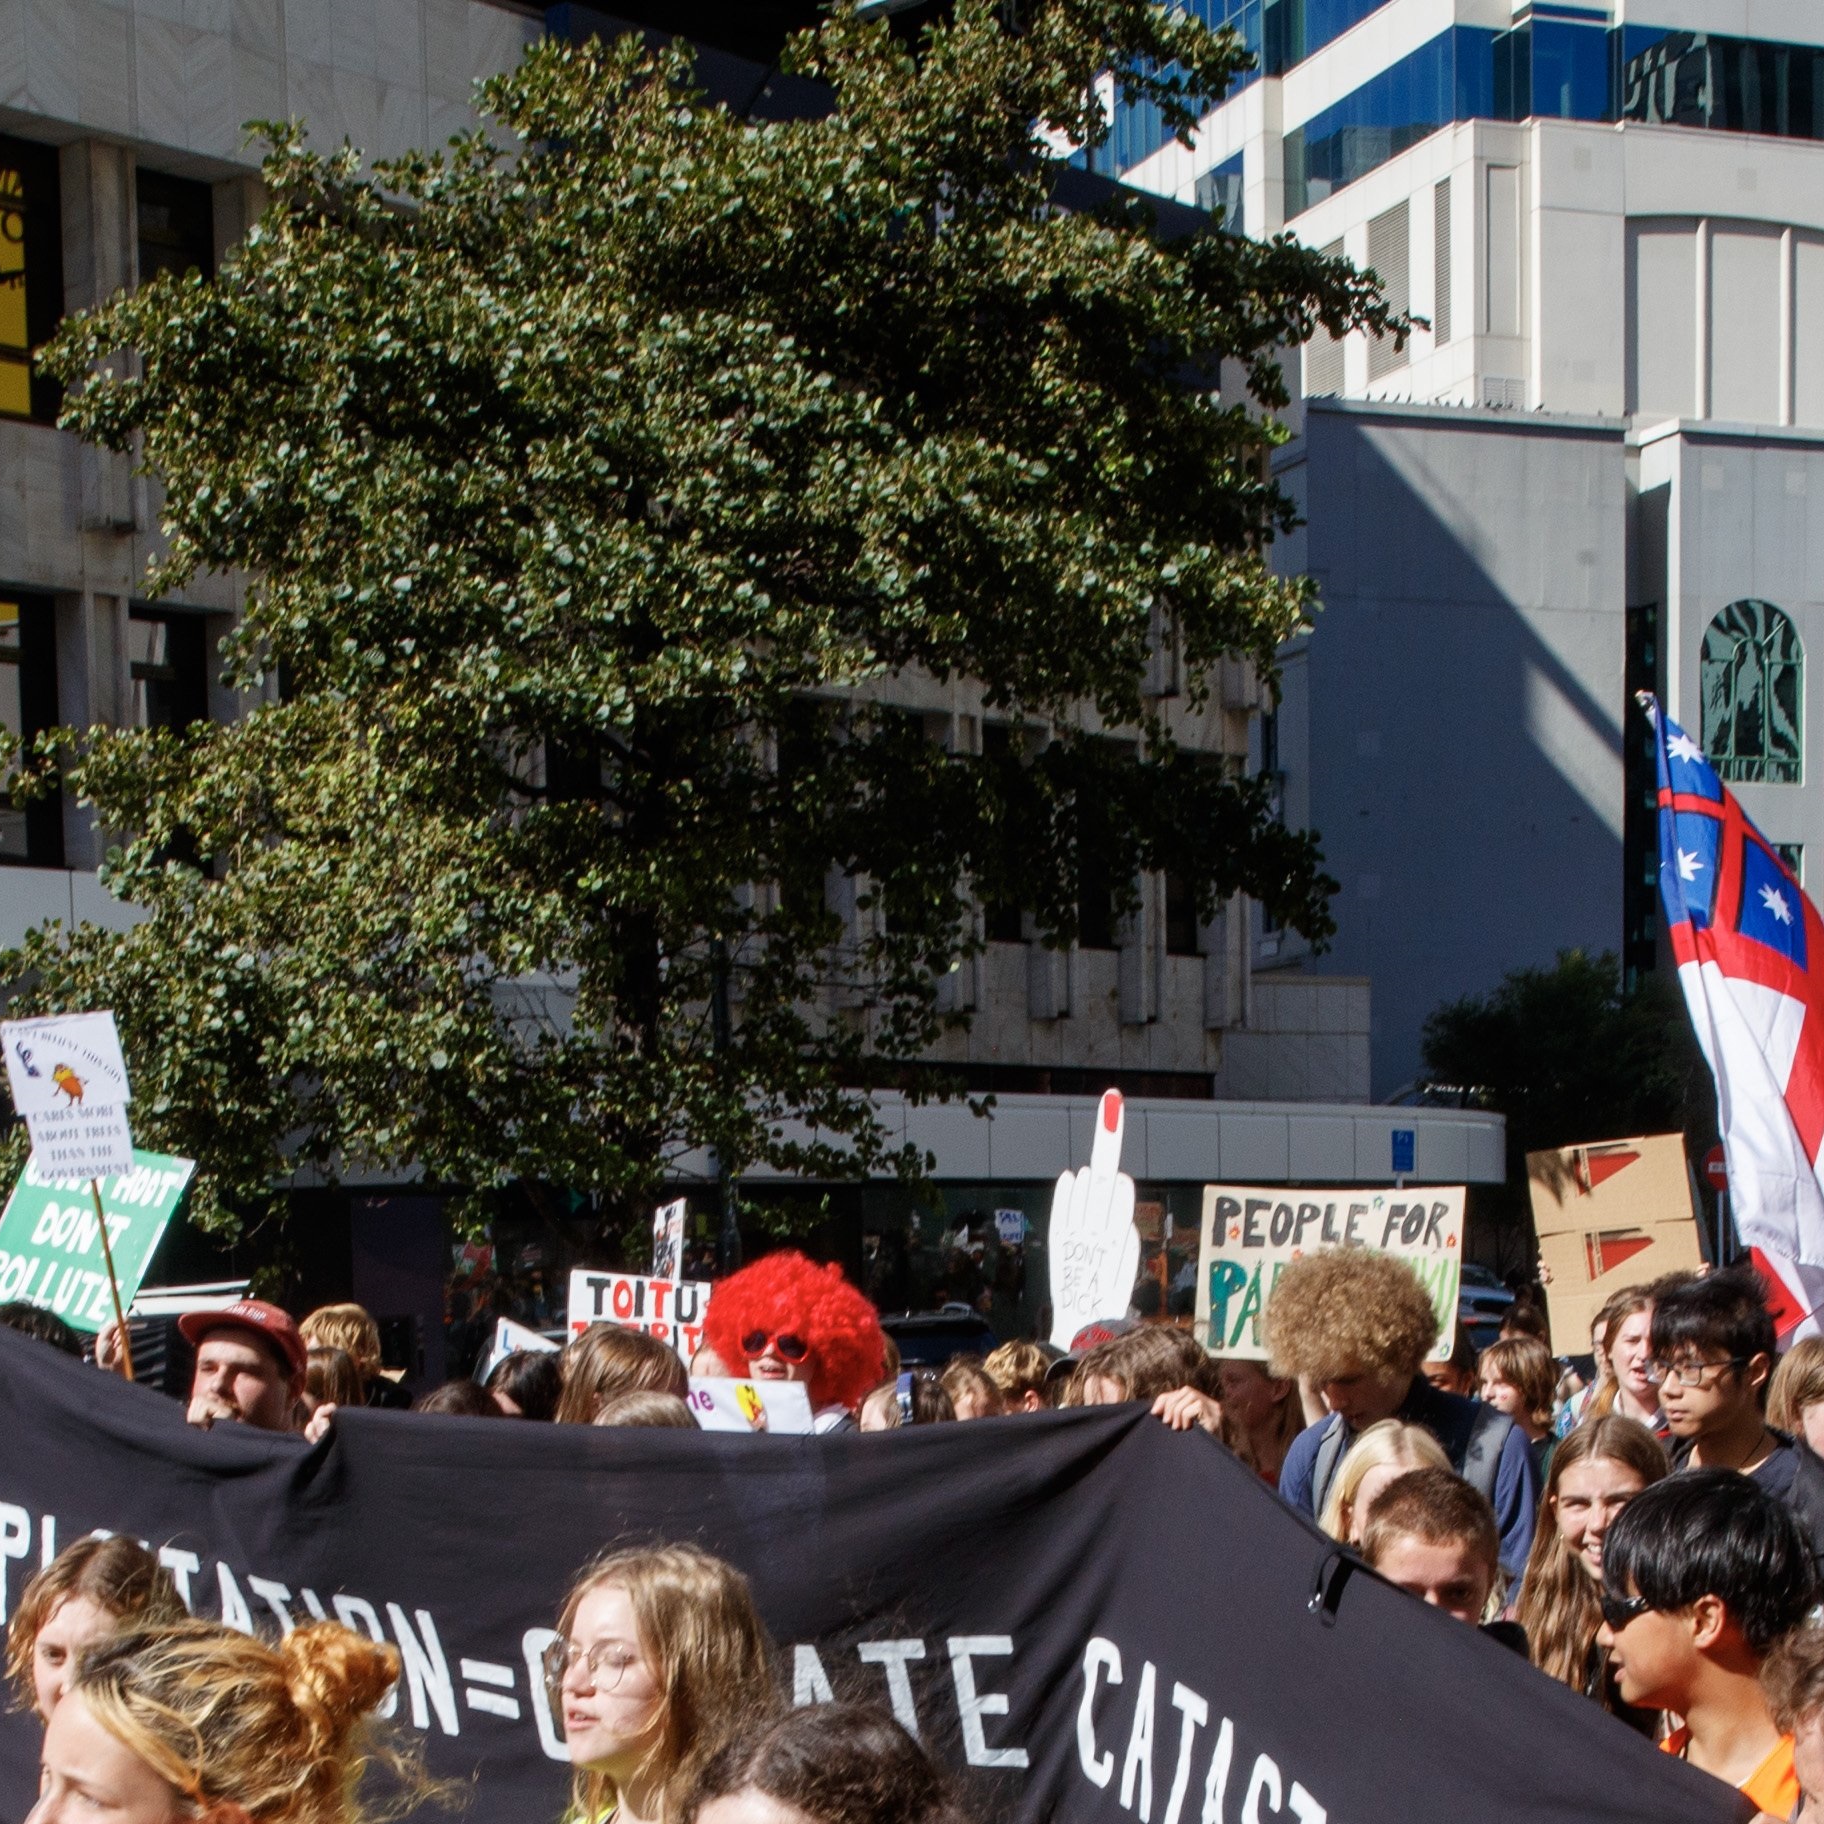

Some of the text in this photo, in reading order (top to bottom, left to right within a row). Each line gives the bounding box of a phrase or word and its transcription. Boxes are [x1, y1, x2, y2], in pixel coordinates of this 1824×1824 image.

[91, 1145, 113, 1159] THE
[31, 1201, 132, 1259] DON'T
[1212, 1196, 1450, 1249] PEOPLE FOR
